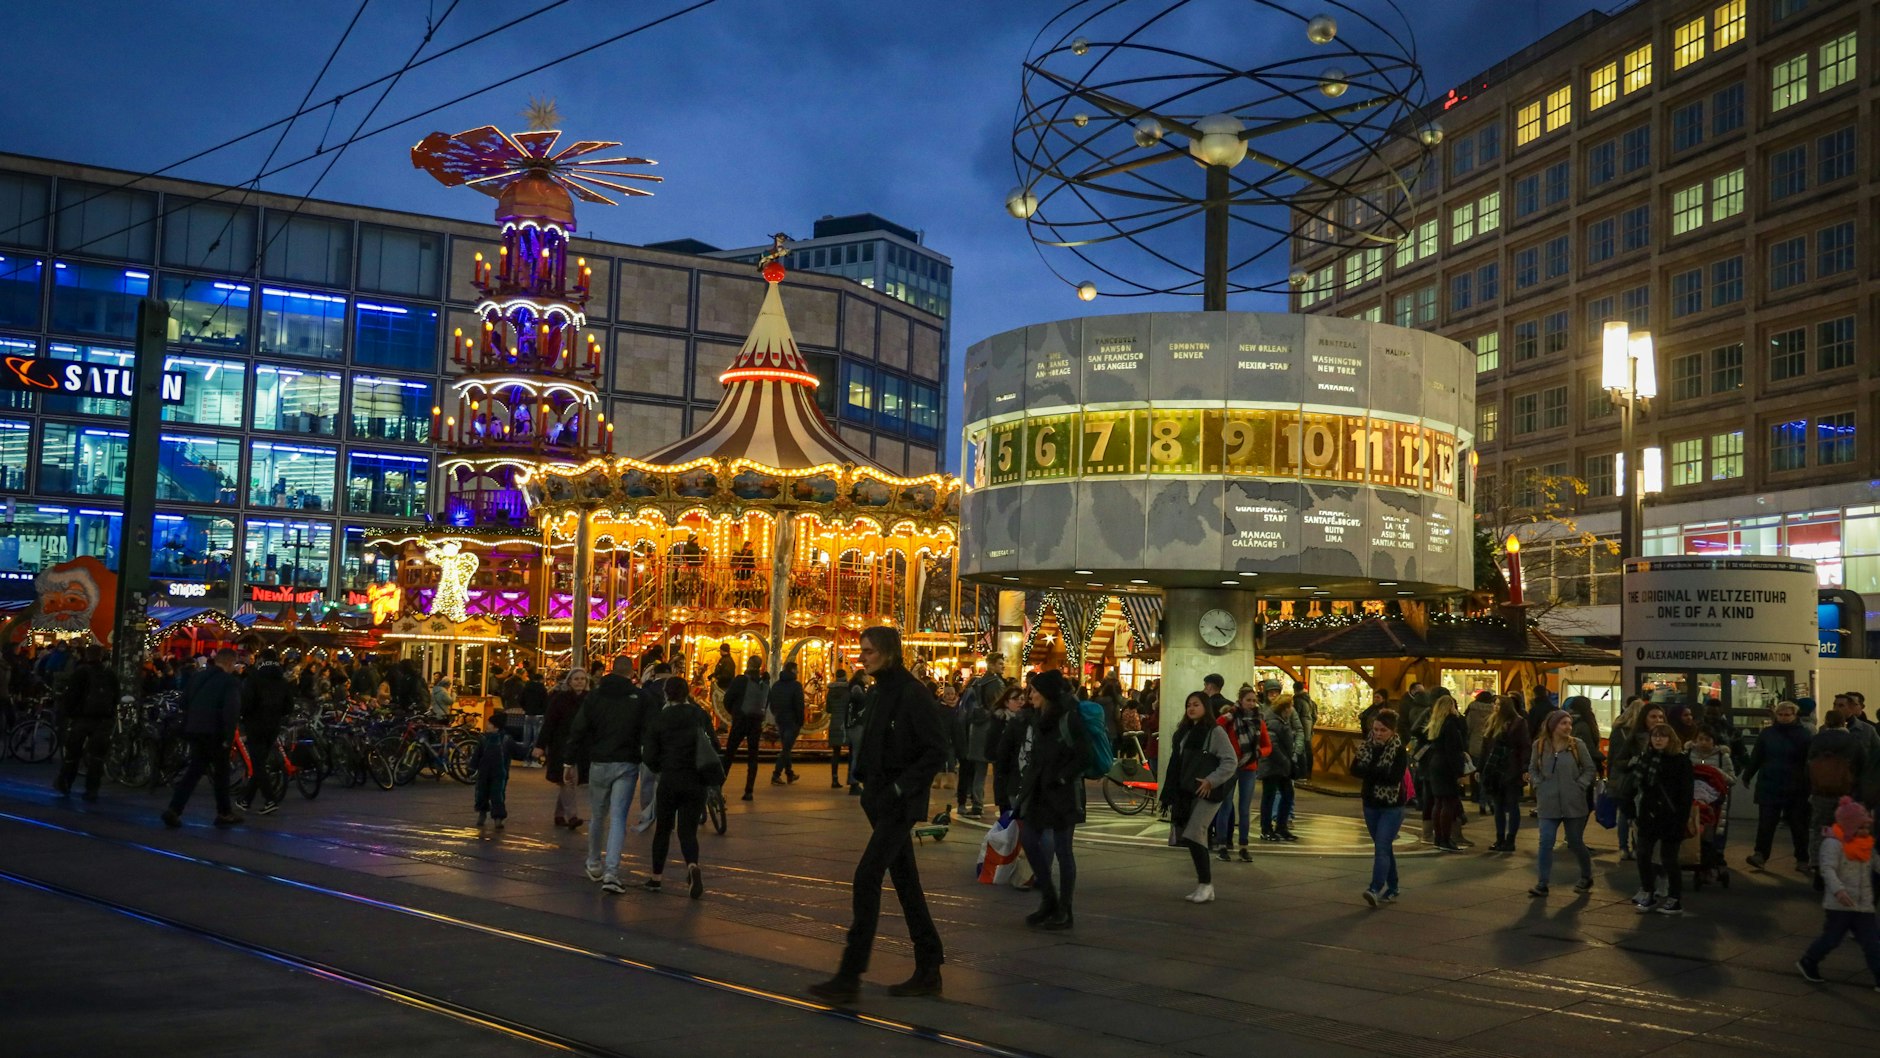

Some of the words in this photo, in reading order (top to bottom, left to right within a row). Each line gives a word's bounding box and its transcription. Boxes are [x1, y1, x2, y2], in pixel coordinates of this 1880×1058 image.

[1100, 344, 1132, 353] DAWSON
[1168, 342, 1210, 350] EDMONTON
[1239, 344, 1256, 352] NEW
[1088, 355, 1102, 363] SAN
[1104, 352, 1144, 362] FRANCISCO
[1173, 351, 1204, 359] DENVER
[1037, 359, 1069, 370] FABANKS
[1312, 354, 1362, 367] WASHINGTON
[1093, 363, 1106, 371] LOS
[1107, 361, 1137, 370] ANGELES
[1317, 364, 1335, 373] NEW
[1337, 366, 1356, 375] YORK
[64, 364, 182, 401] SATUN
[998, 432, 1013, 472] 5
[1035, 426, 1057, 467] 6
[1085, 421, 1116, 462] 7
[1151, 420, 1183, 463] 8
[1221, 420, 1254, 465] 9
[1281, 423, 1335, 467] 10
[1351, 429, 1384, 471] 11
[1401, 435, 1430, 478] 12
[1437, 443, 1455, 486] 13
[1263, 514, 1288, 522] STADT
[1324, 526, 1344, 535] QUITO
[1385, 522, 1393, 530] LA
[1240, 531, 1282, 540] MANAGUA
[1325, 534, 1343, 543] LIMA
[1232, 539, 1278, 548] GALÁPAGOS
[169, 583, 206, 598] snipes
[1628, 591, 1639, 603] THE
[1641, 590, 1691, 603] ORIGINAL
[1697, 589, 1786, 604] WELTZEITUHR
[1657, 606, 1680, 619] ONE
[1685, 606, 1702, 619] OF
[1707, 606, 1717, 619] A
[1722, 606, 1755, 619] KIND
[1646, 651, 1729, 661] ALEXANDERPLATZ
[1731, 652, 1792, 663] INFORMATION
